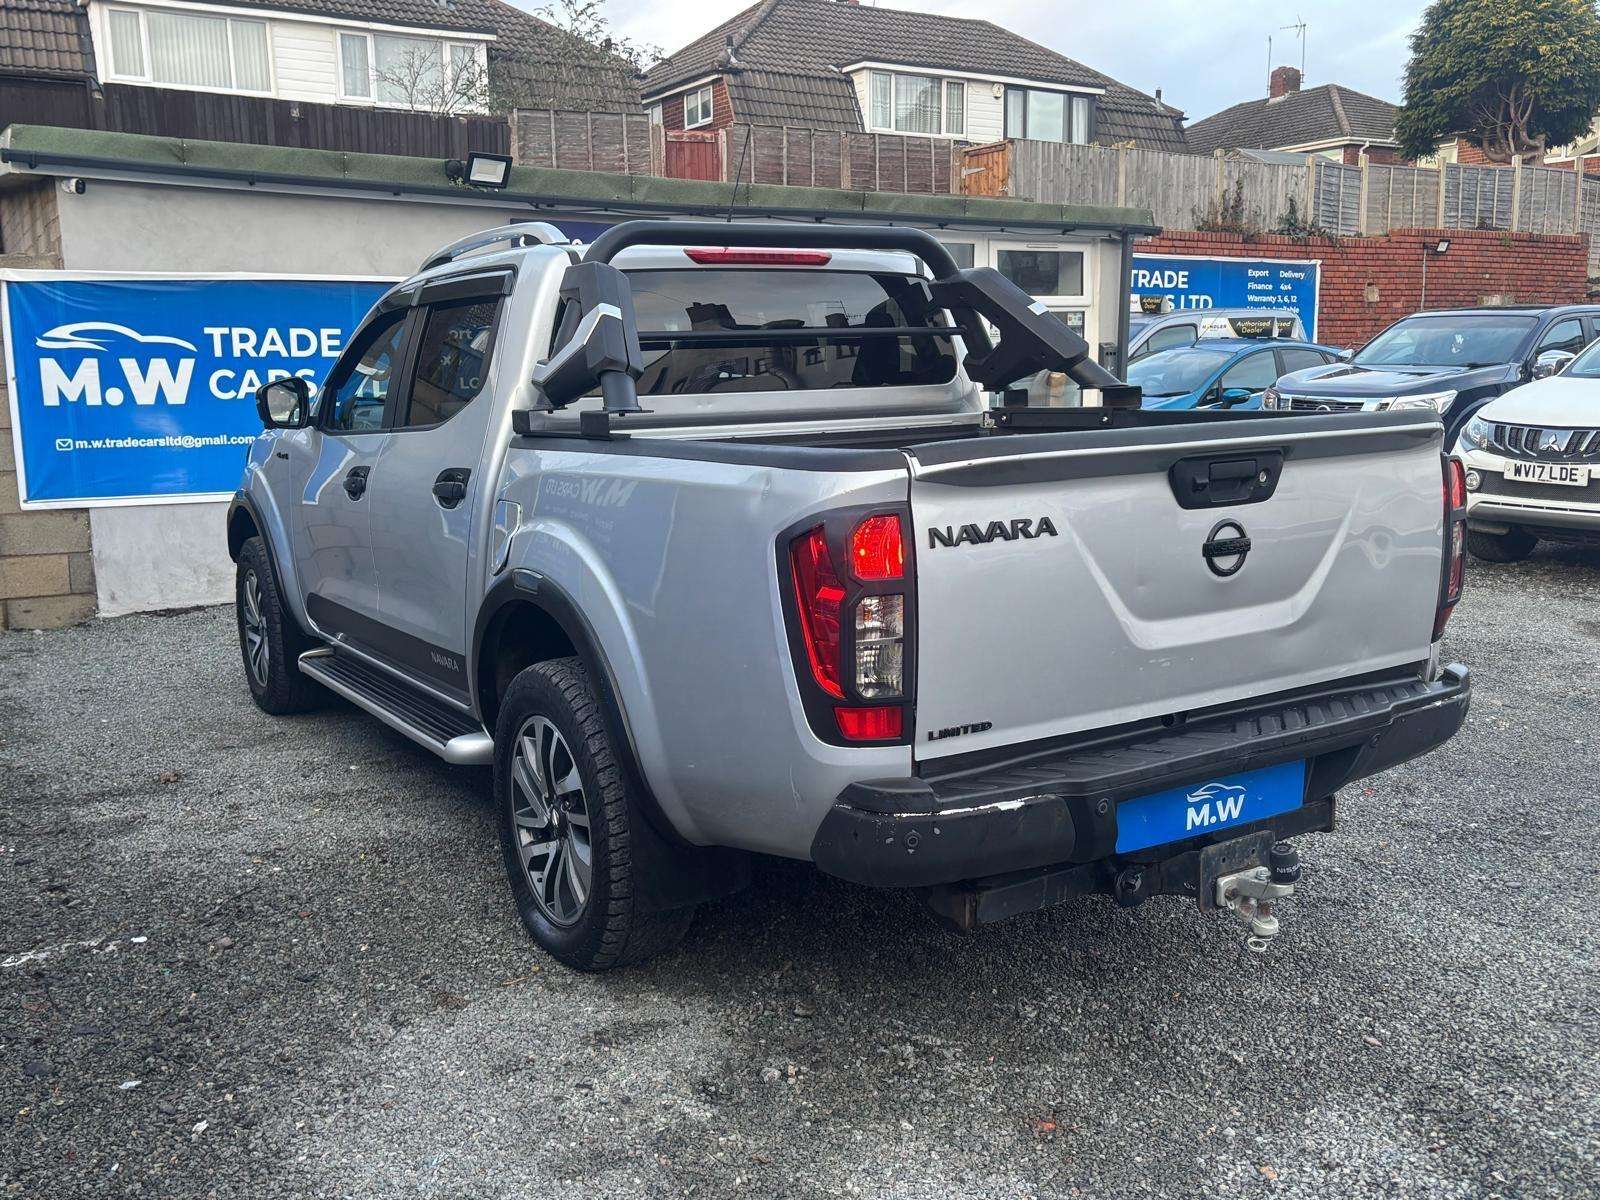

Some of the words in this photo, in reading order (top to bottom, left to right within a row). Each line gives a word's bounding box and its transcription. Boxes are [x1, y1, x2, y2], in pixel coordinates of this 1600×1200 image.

[1131, 270, 1189, 288] TRADE
[1248, 269, 1269, 278] Export
[1280, 270, 1305, 280] Delivery
[1247, 281, 1273, 290] Finance
[1180, 294, 1213, 310] LTD
[1247, 294, 1276, 303] Warranty
[1291, 295, 1298, 303] 12
[1236, 320, 1271, 328] Authorised
[1241, 326, 1263, 334] Dealer
[203, 327, 342, 358] TRADE
[39, 358, 196, 407] M.W
[75, 434, 256, 449] m.w.tradecarsltd@gmail.com
[1514, 463, 1546, 479] WV17
[1549, 466, 1579, 482] LDE
[928, 516, 1058, 549] NAVARA
[430, 650, 460, 672] NAVARA
[928, 721, 993, 741] LIMITED
[1186, 794, 1245, 831] M.W
